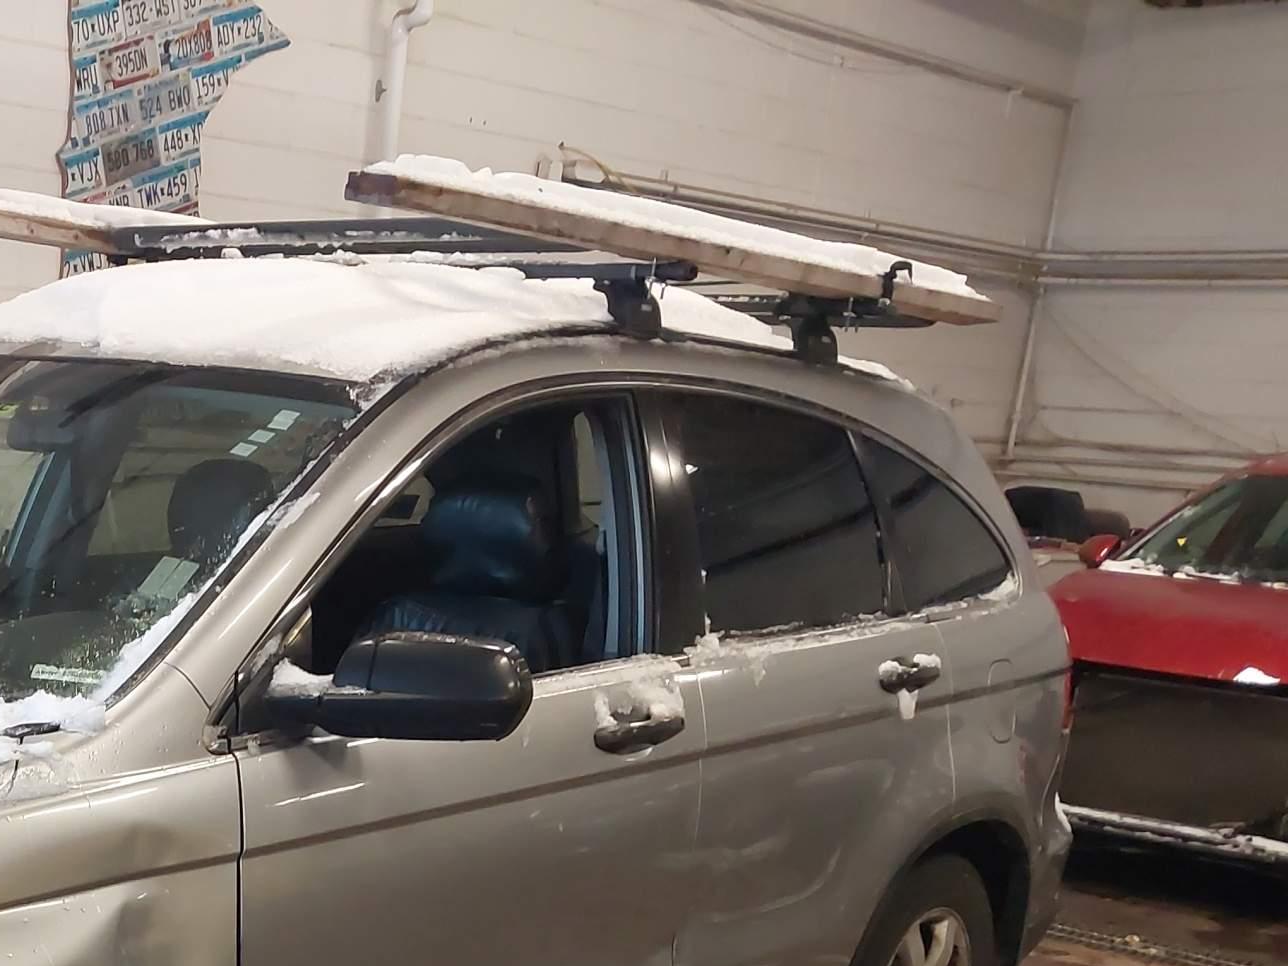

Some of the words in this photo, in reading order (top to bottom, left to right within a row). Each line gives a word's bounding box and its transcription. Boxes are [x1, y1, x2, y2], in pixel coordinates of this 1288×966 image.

[97, 10, 119, 36] UXP
[126, 1, 149, 26] 332
[217, 23, 236, 48] ADY
[243, 14, 262, 40] 232
[195, 73, 216, 99] 159
[85, 110, 106, 137] 808
[108, 102, 129, 128] TXN
[163, 133, 183, 153] 448
[77, 157, 102, 184] VJX
[137, 183, 160, 208] TWK
[167, 173, 187, 198] 459
